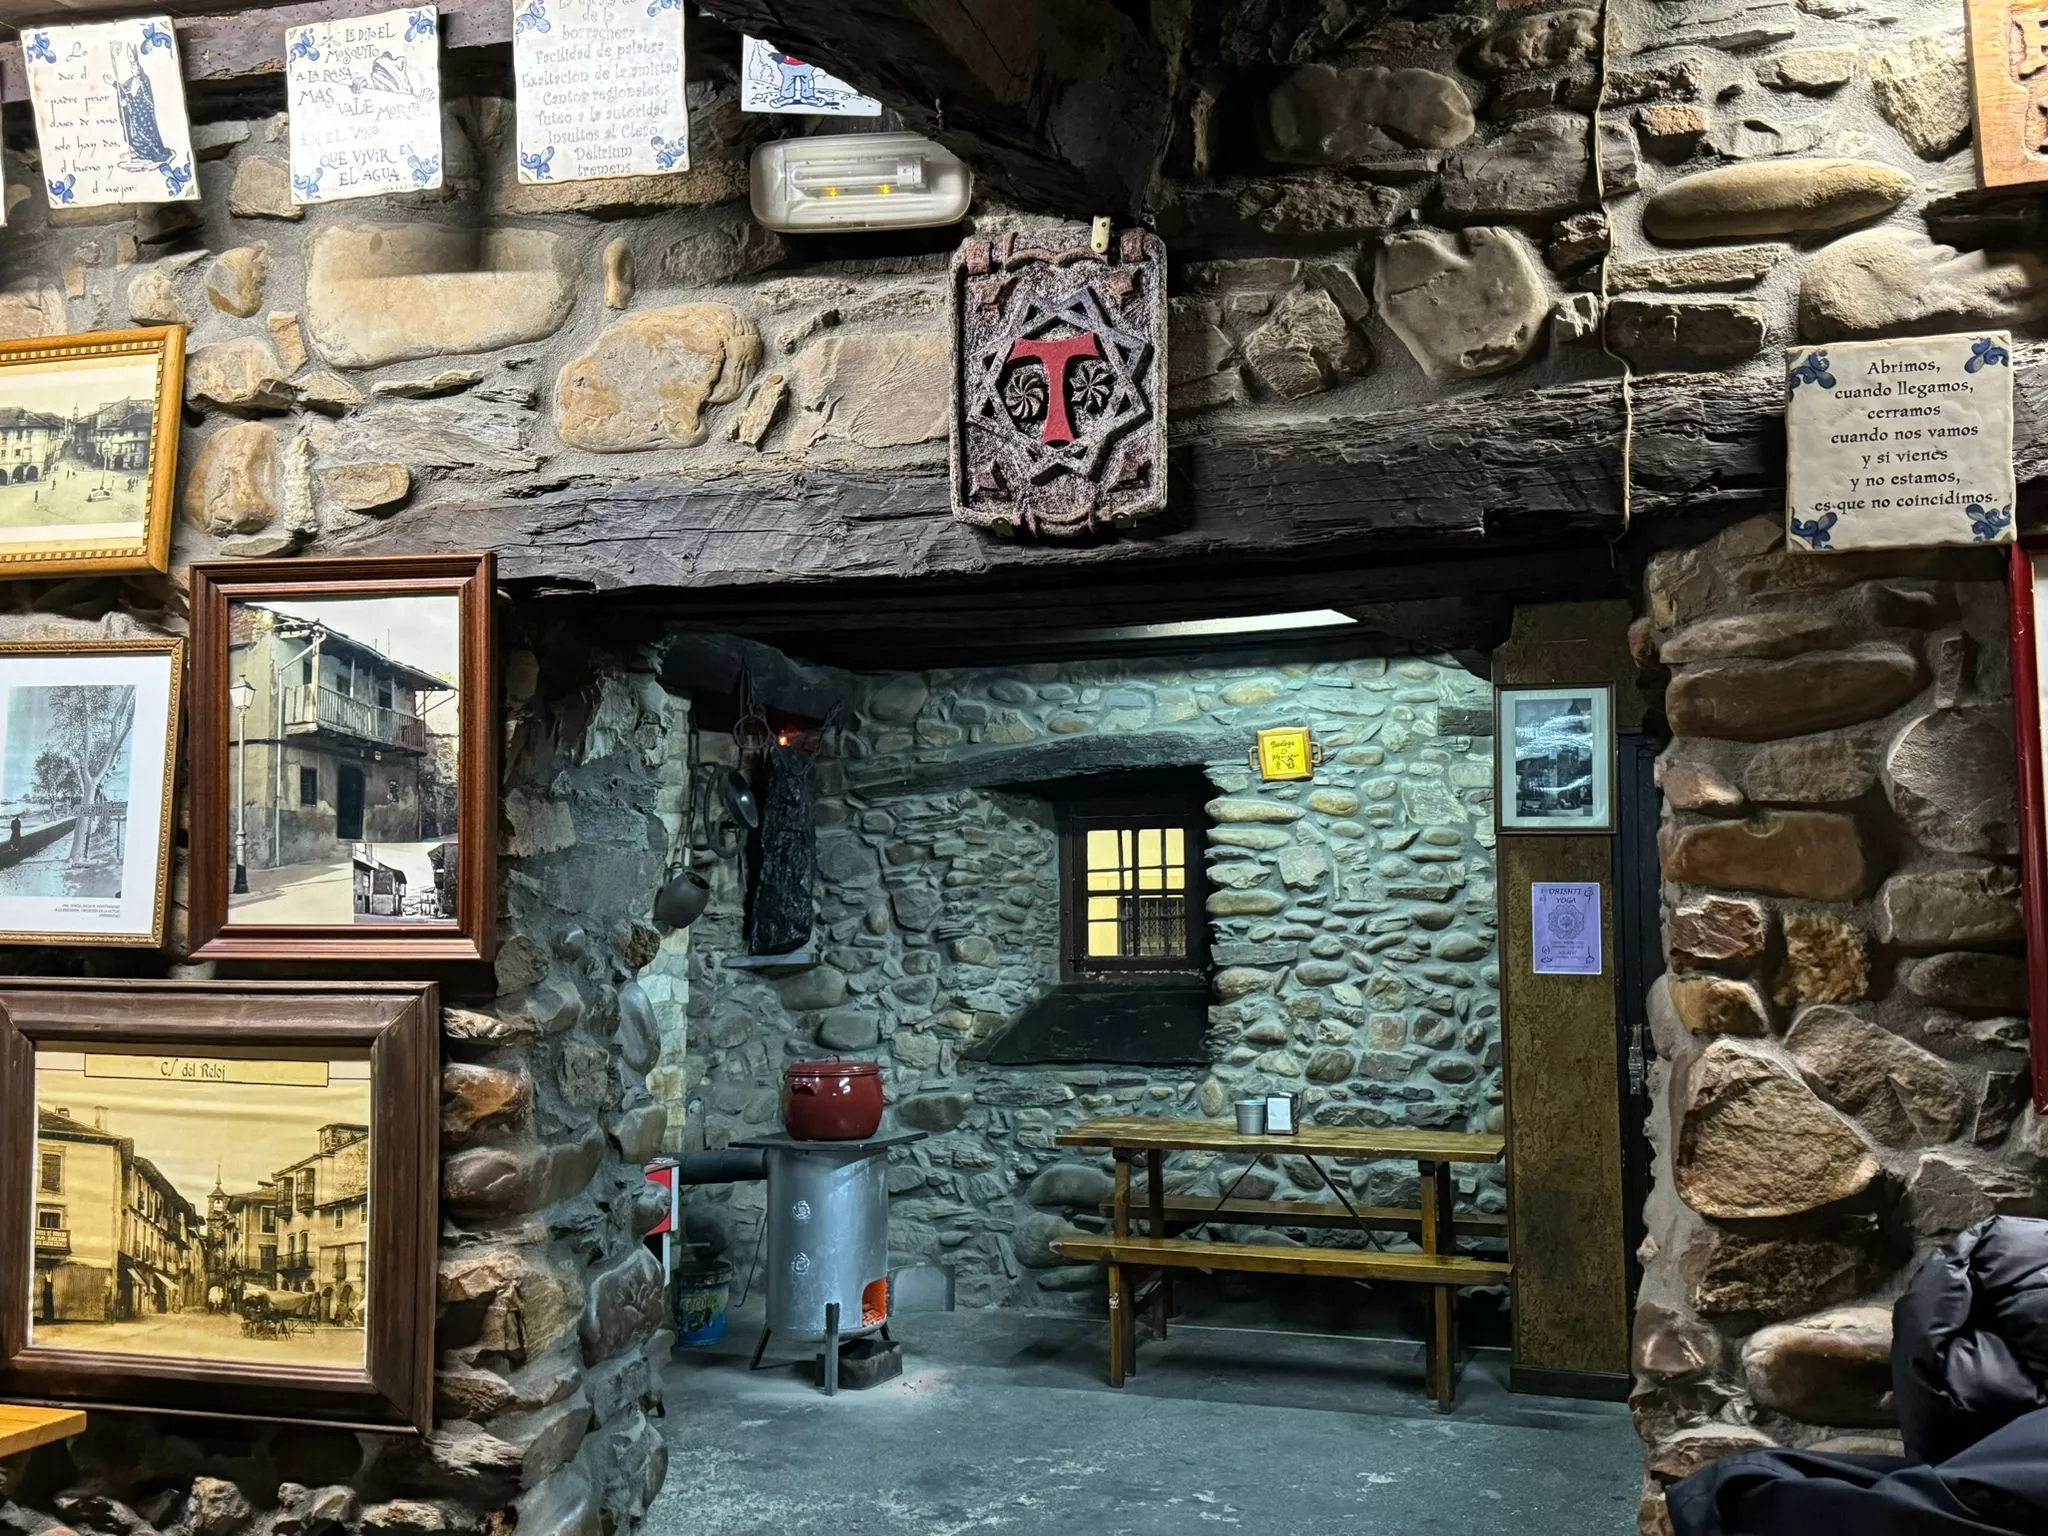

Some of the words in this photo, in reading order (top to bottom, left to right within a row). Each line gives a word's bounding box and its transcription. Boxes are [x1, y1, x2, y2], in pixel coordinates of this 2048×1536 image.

[582, 4, 598, 22] de
[603, 7, 615, 23] la
[345, 29, 357, 43] LE
[378, 22, 397, 39] EL
[561, 23, 636, 41] borrachera
[65, 41, 88, 63] Lo
[324, 44, 380, 65] MOSQUITO
[535, 43, 592, 65] Facilidad
[597, 43, 612, 58] de
[617, 39, 665, 60] palabra
[295, 72, 306, 81] A
[307, 70, 320, 83] LA
[594, 65, 610, 81] de
[615, 63, 627, 80] la
[630, 57, 680, 78] amistad
[50, 95, 78, 116] padre
[84, 95, 110, 112] prior
[297, 87, 335, 108] MAS
[337, 97, 375, 117] VALE
[542, 90, 588, 106] Cantos
[79, 118, 90, 126] de
[535, 109, 573, 127] Tuteo
[578, 113, 584, 122] a
[589, 106, 602, 122] la
[605, 99, 668, 120] autoridad
[325, 129, 346, 145] EL
[547, 127, 600, 145] Insultos
[604, 124, 617, 139] al
[620, 122, 658, 139] Clero
[54, 136, 71, 151] solo
[76, 135, 97, 158] hay
[574, 144, 633, 161] Delirium
[72, 159, 101, 172] bueno
[107, 164, 114, 180] y
[319, 150, 348, 170] QUE
[577, 163, 632, 176] tremens
[338, 167, 359, 186] EL
[1866, 358, 1942, 376] Abrimos,
[1834, 383, 1892, 400] cuando
[1897, 380, 1975, 399] llegamos,
[1867, 404, 1942, 420] cerramos
[1830, 427, 1889, 445] cuando
[1894, 429, 1923, 441] nos
[1927, 424, 1980, 439] vamos
[1861, 453, 1872, 470] y
[1877, 451, 1891, 464] si
[1895, 448, 1949, 463] vienes
[1849, 476, 1861, 493] y
[1865, 475, 1885, 488] no
[1890, 471, 1962, 487] estamos,
[1814, 500, 1832, 512] es
[1835, 499, 1866, 515] que
[1871, 496, 1891, 509] no
[1895, 491, 1999, 508] coincidimos.
[181, 1062, 196, 1078] del
[200, 1062, 227, 1082] Reloj
